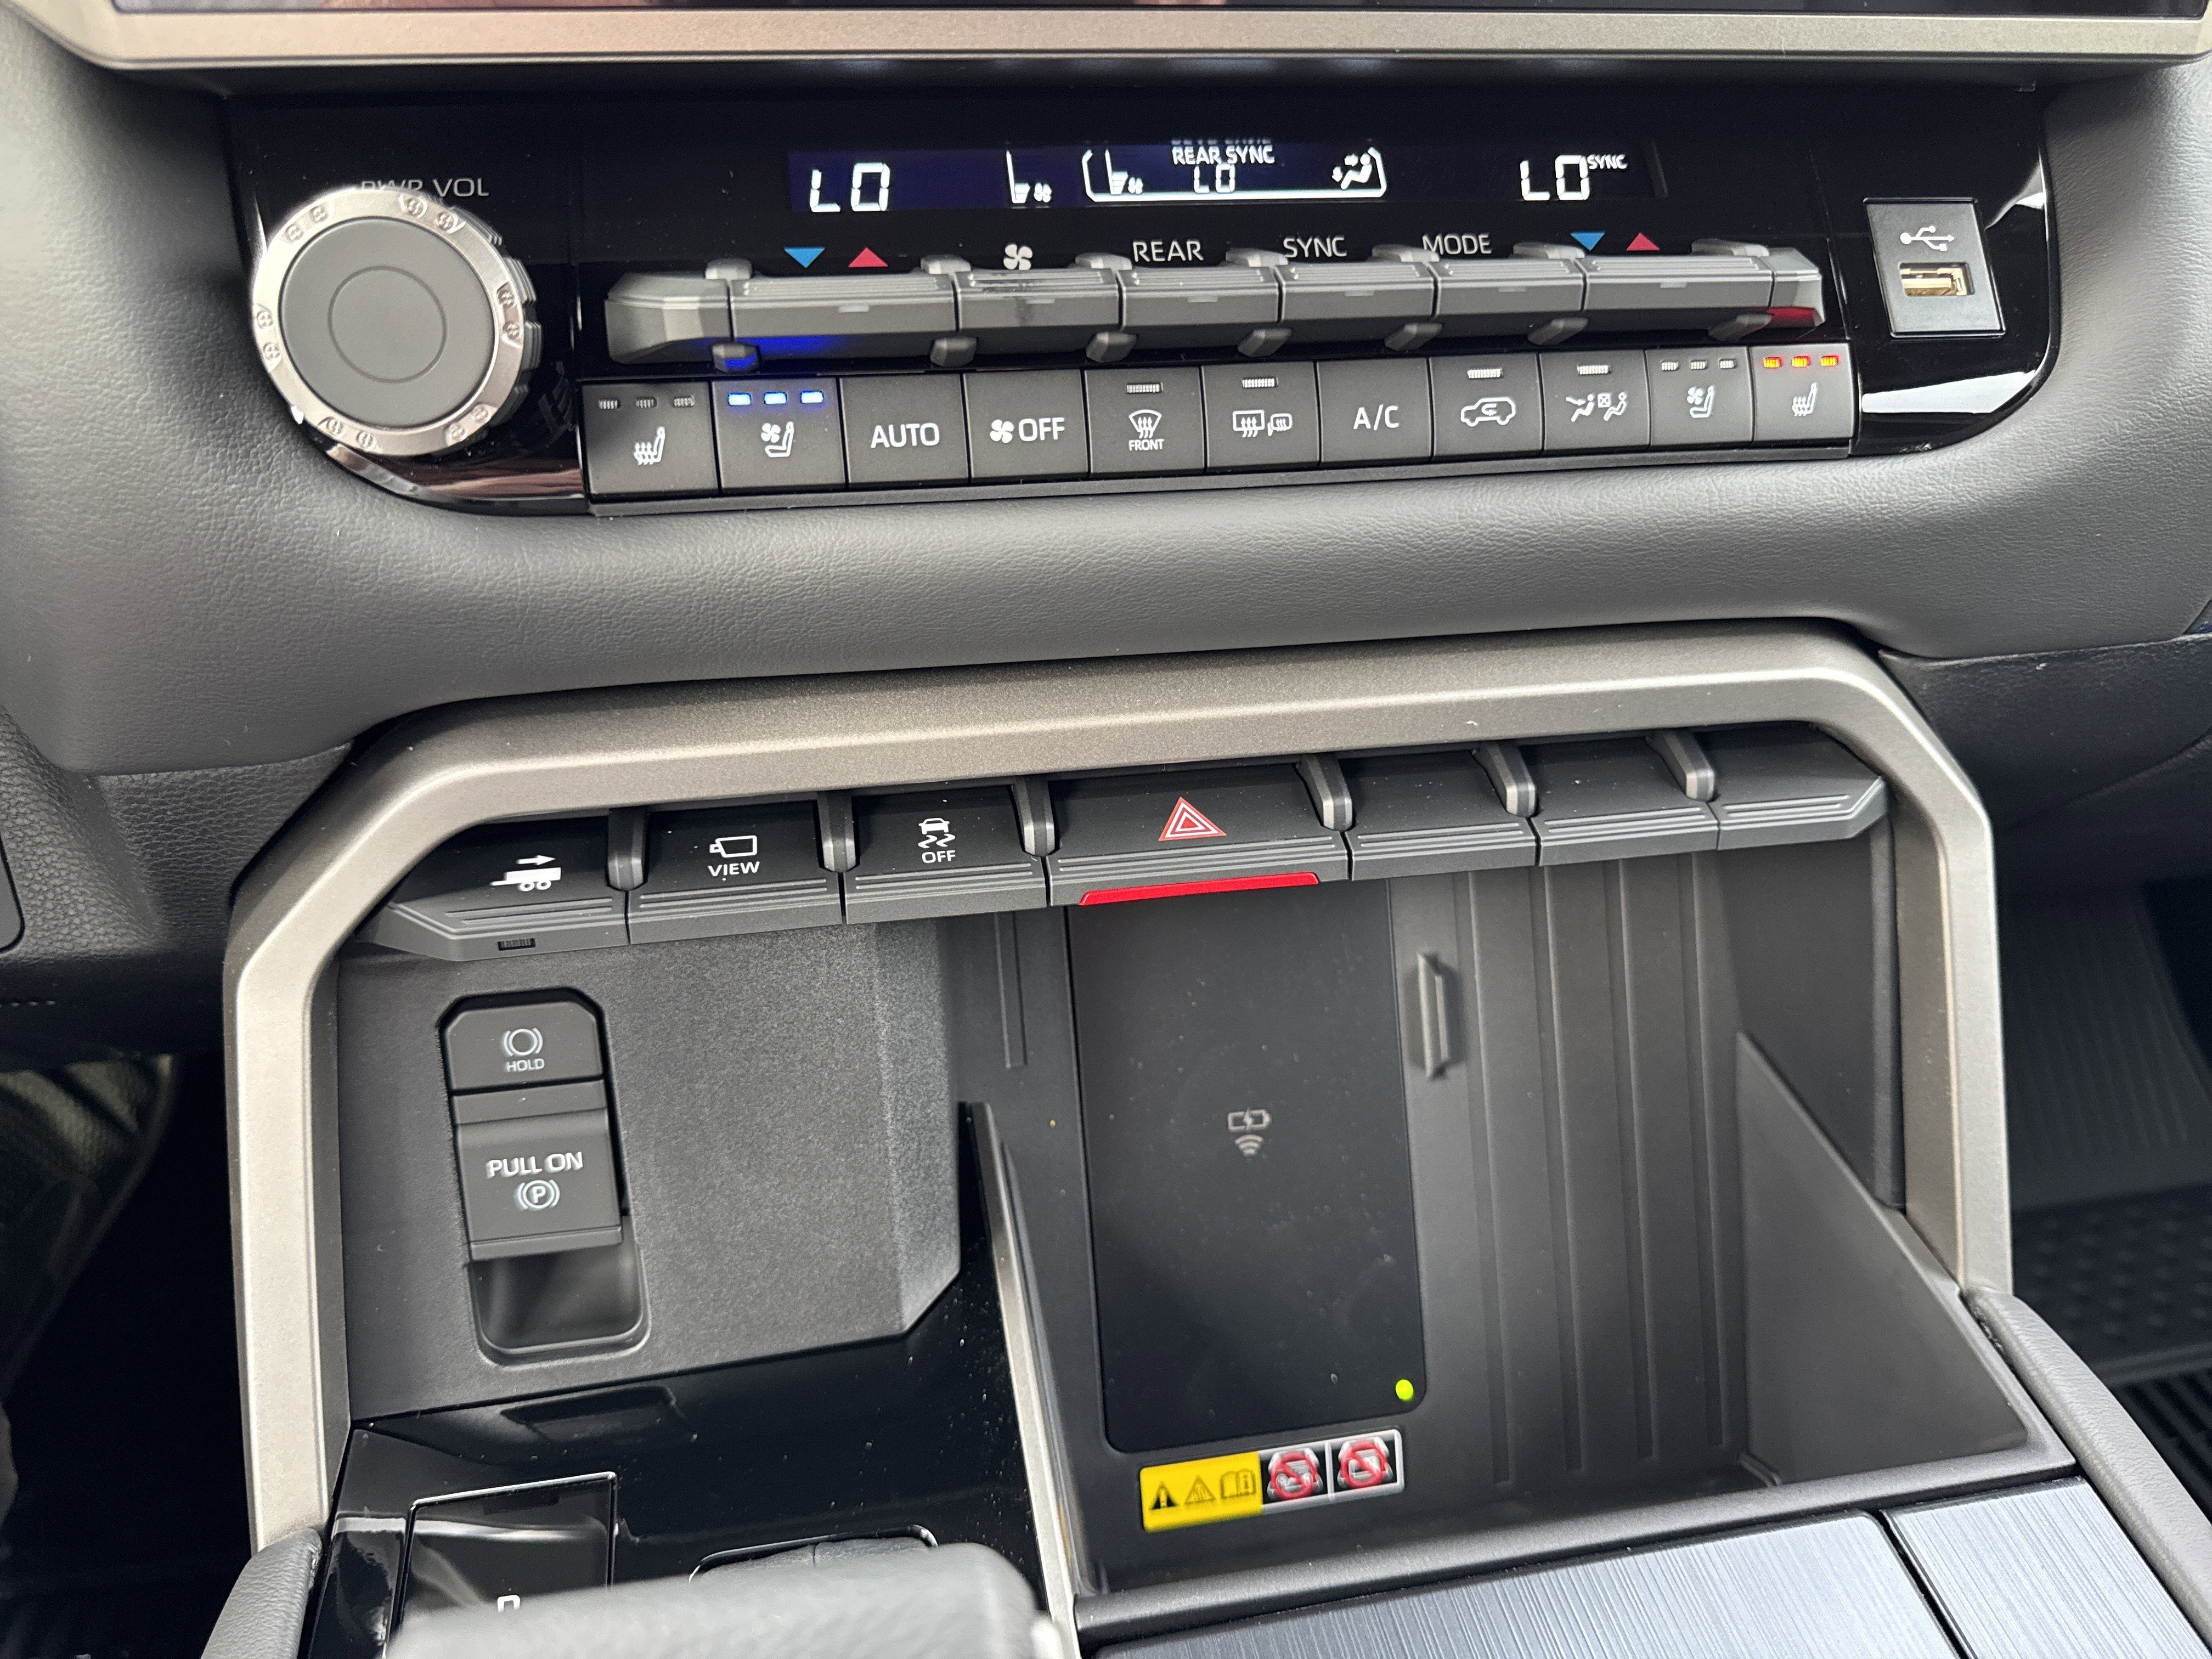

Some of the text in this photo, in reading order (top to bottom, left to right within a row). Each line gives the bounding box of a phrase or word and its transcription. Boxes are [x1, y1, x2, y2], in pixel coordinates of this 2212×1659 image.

[1172, 145, 1275, 165] REAR SYNC
[1587, 154, 1628, 170] SYNC
[433, 177, 490, 197] VOL
[809, 162, 890, 213] LO
[1193, 163, 1235, 194] LO
[1520, 154, 1588, 201] LO
[1132, 240, 1204, 262] REAR
[1283, 236, 1347, 258] SYNC
[1422, 233, 1492, 255] MODE
[1353, 404, 1400, 431] A/C
[871, 422, 940, 449] AUTO
[1018, 416, 1065, 442] OFF
[1128, 438, 1164, 451] FRONT
[922, 850, 956, 864] OFF
[708, 861, 760, 877] VIEW
[505, 1057, 545, 1073] HOLD
[486, 1152, 584, 1179] PULL ON
